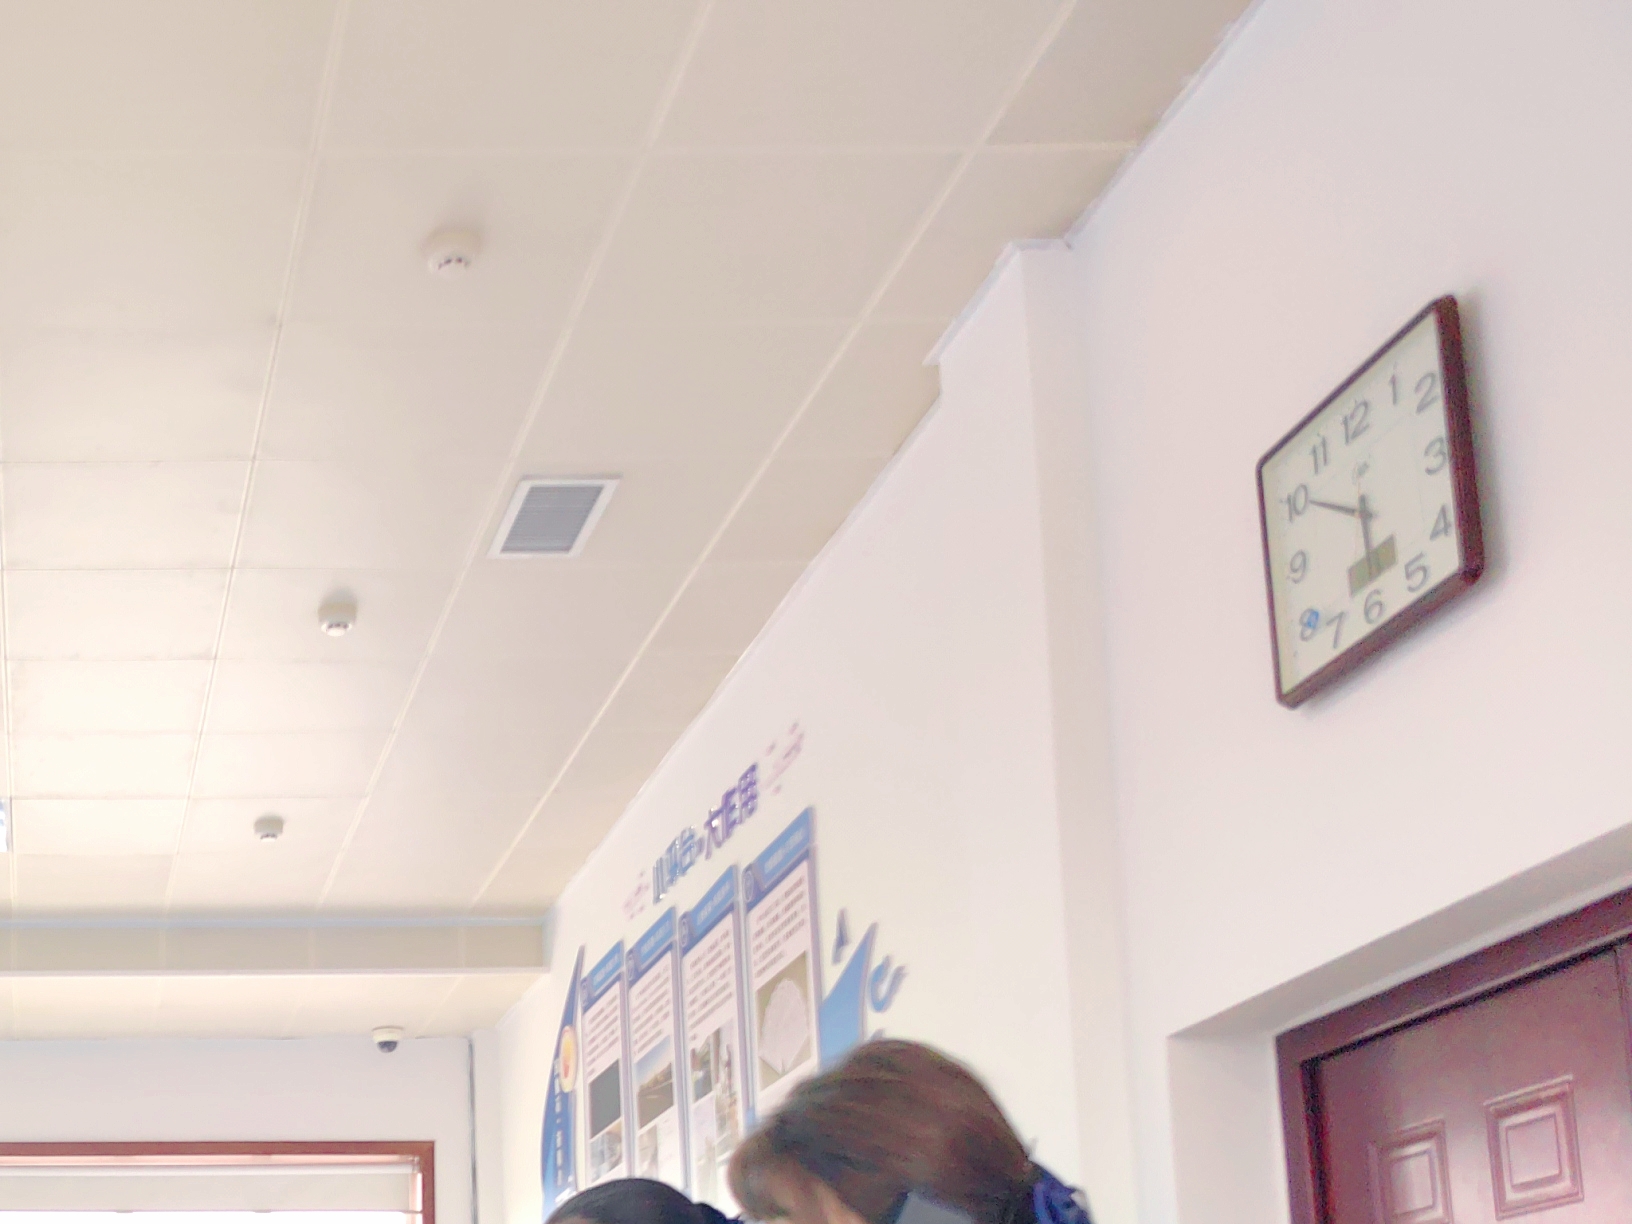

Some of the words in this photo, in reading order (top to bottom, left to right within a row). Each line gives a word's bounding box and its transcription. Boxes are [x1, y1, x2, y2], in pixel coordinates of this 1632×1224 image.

[1414, 371, 1439, 415] 2
[1342, 399, 1371, 446] 12
[1310, 435, 1329, 475] 11
[1424, 436, 1449, 476] 3
[1284, 484, 1309, 523] 10
[1429, 505, 1452, 541] 4
[1288, 550, 1308, 584] 9
[1404, 553, 1429, 593] 5
[1298, 607, 1319, 642] 8
[1363, 588, 1386, 626] 6
[1326, 610, 1348, 649] 7
